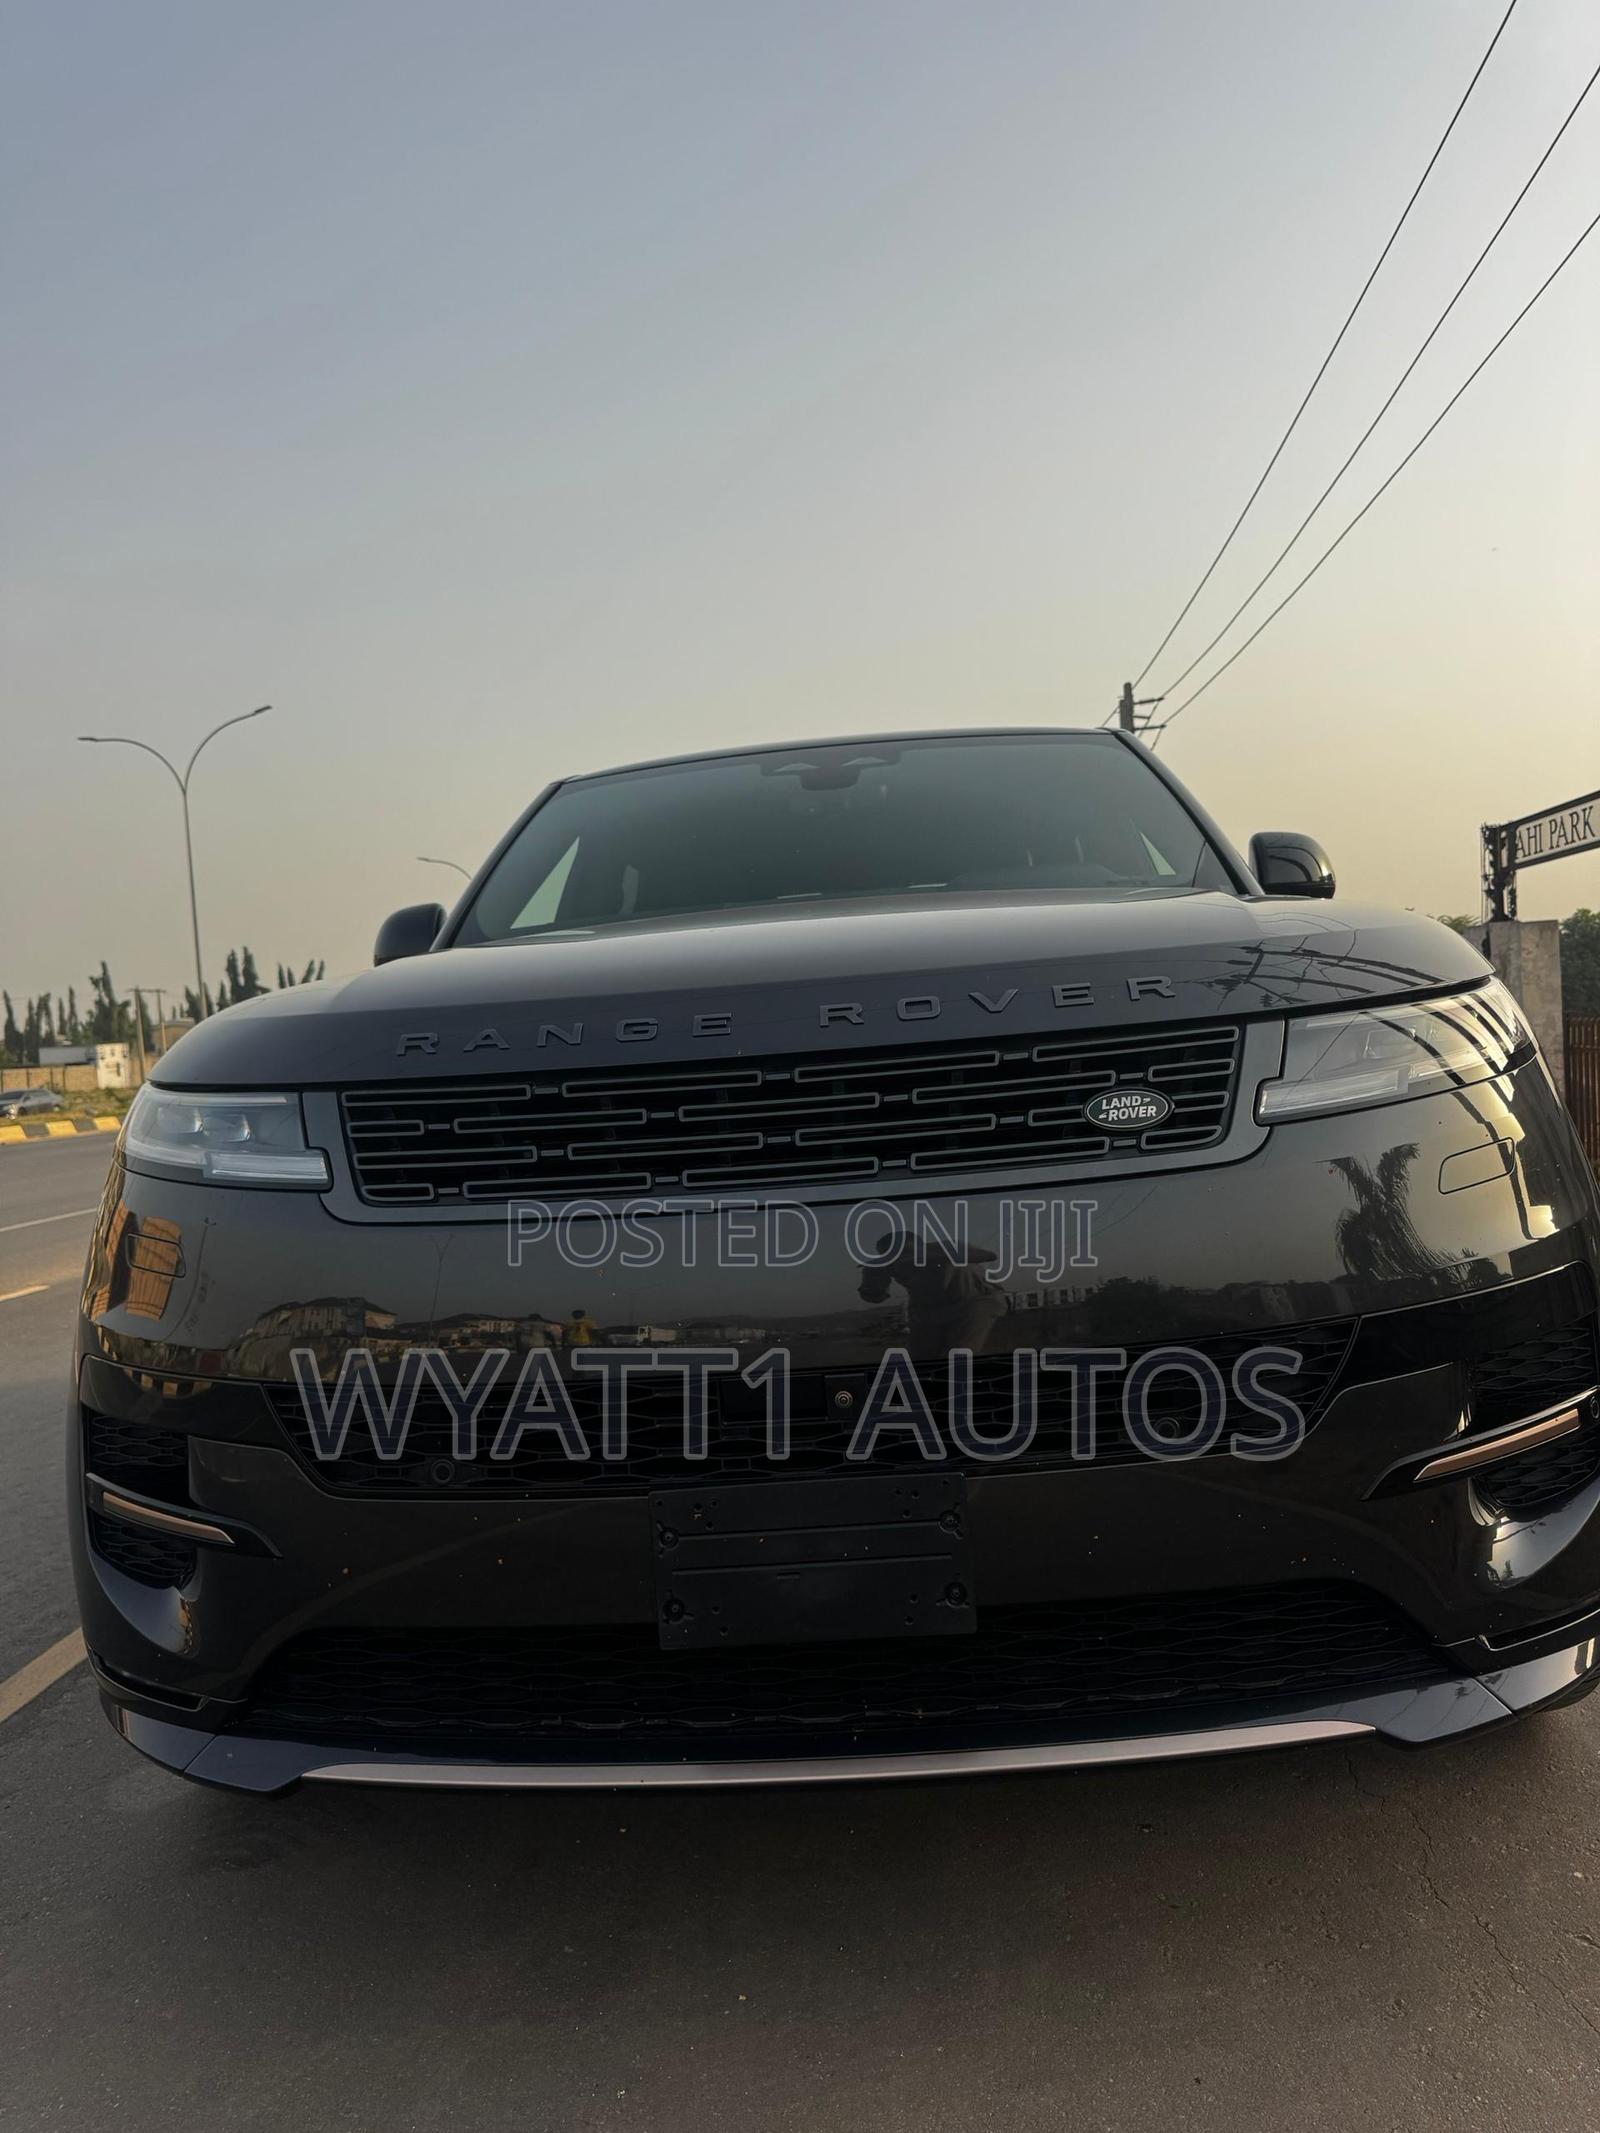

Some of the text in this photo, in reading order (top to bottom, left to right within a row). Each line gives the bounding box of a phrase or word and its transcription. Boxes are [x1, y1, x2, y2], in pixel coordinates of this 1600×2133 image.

[1548, 805, 1596, 850] PARK
[396, 975, 1176, 1056] RANGE ROVER
[1101, 1096, 1141, 1110] LAND
[1108, 1105, 1157, 1121] ROVER
